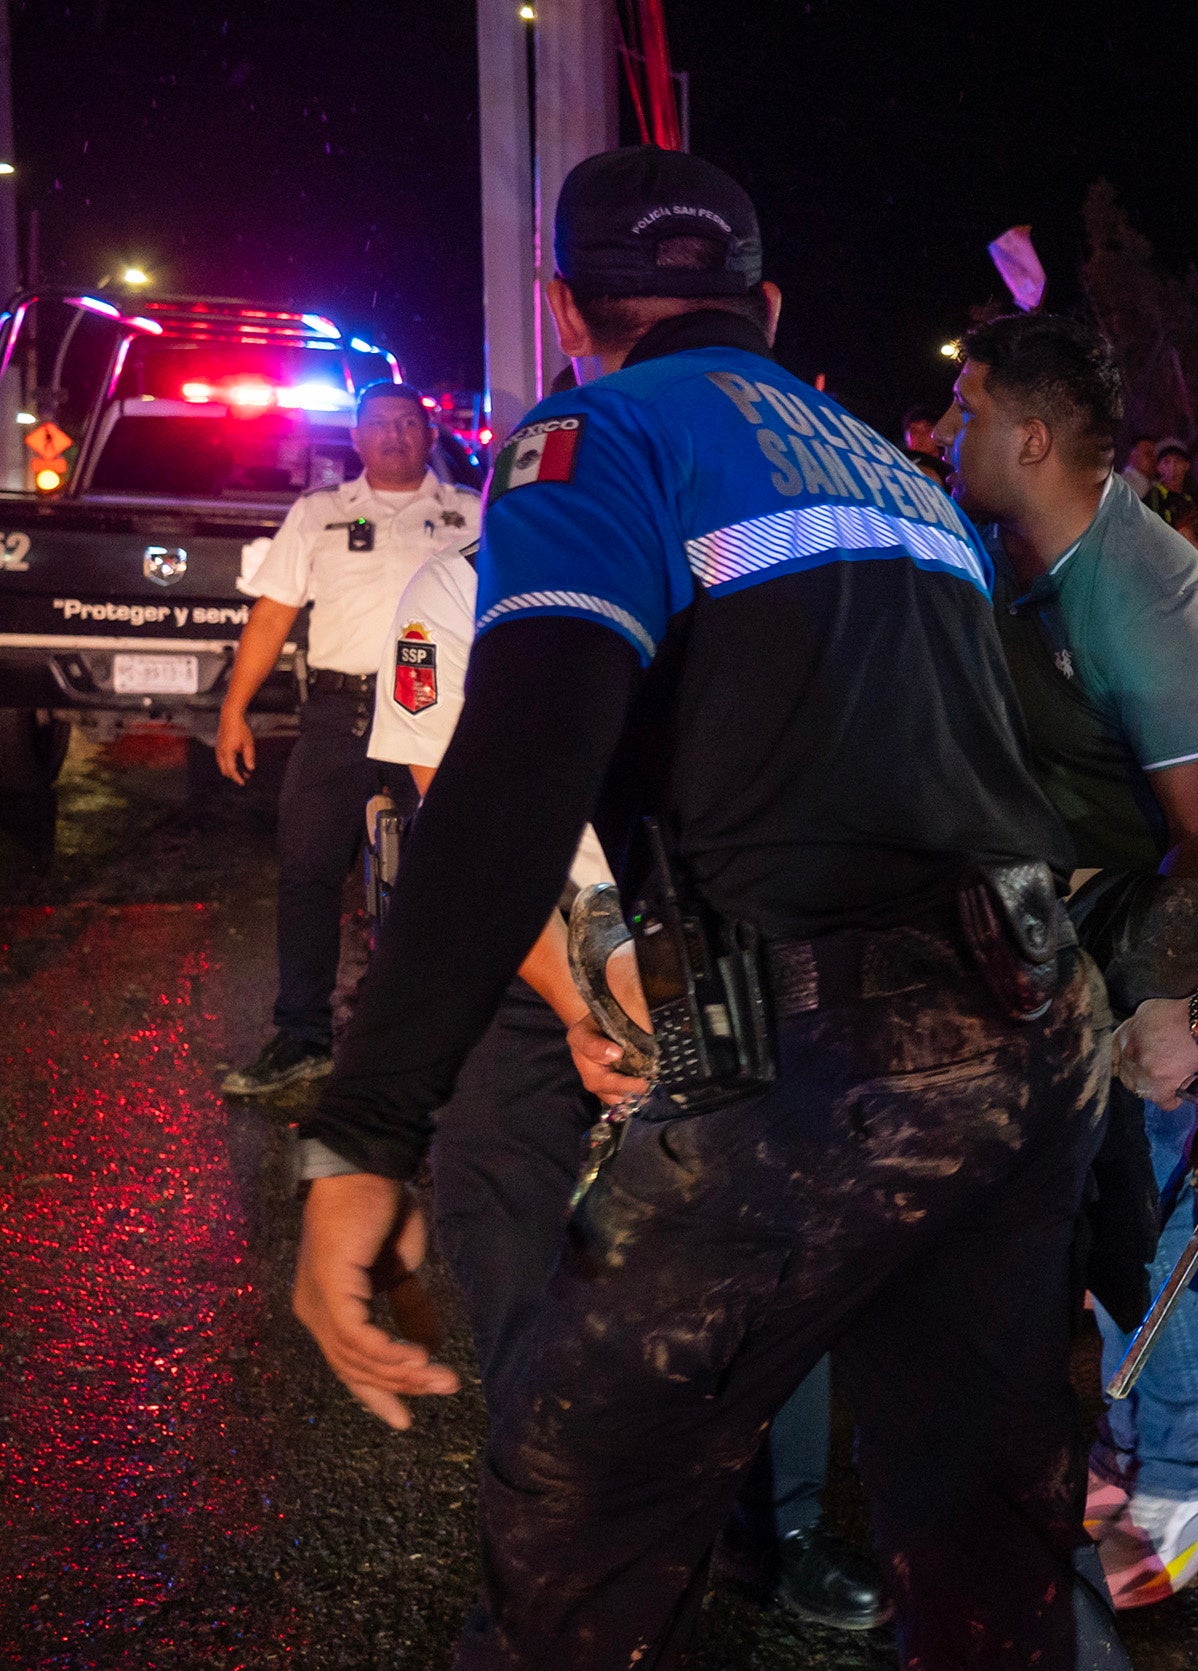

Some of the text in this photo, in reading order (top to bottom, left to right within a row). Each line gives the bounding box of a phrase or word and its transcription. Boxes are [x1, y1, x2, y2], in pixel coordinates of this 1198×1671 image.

[673, 205, 697, 216] SAN
[698, 208, 732, 233] PEDRO
[756, 429, 864, 500] SAN
[174, 606, 189, 627] y
[402, 648, 427, 663] SSP
